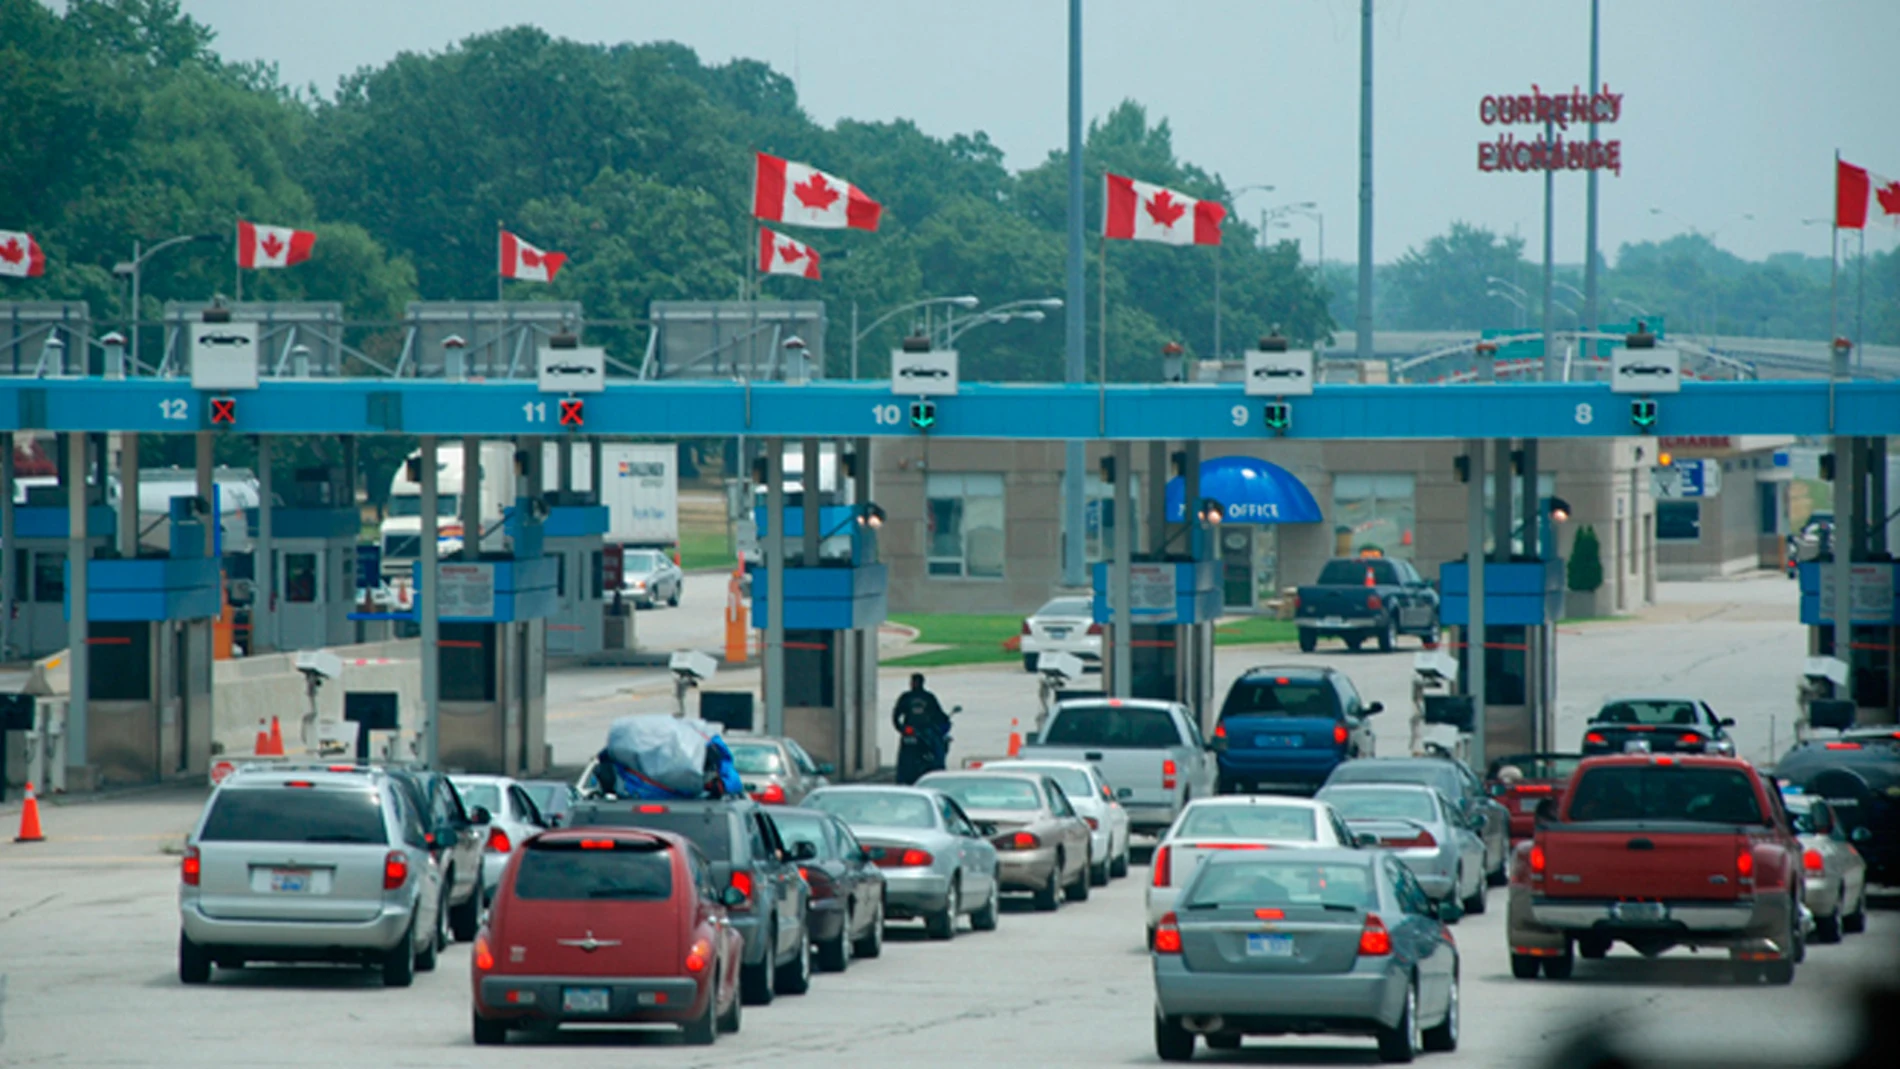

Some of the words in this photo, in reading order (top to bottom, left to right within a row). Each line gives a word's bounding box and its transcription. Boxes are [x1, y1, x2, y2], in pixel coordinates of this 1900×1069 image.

[1480, 85, 1622, 129] CURRENCY
[1478, 135, 1620, 175] EXCHANGE
[160, 400, 188, 419] 12
[522, 402, 547, 422] 11
[872, 404, 901, 425] 10
[1231, 405, 1248, 425] 9
[1575, 403, 1593, 425] 8
[1229, 503, 1279, 517] OFFICE
